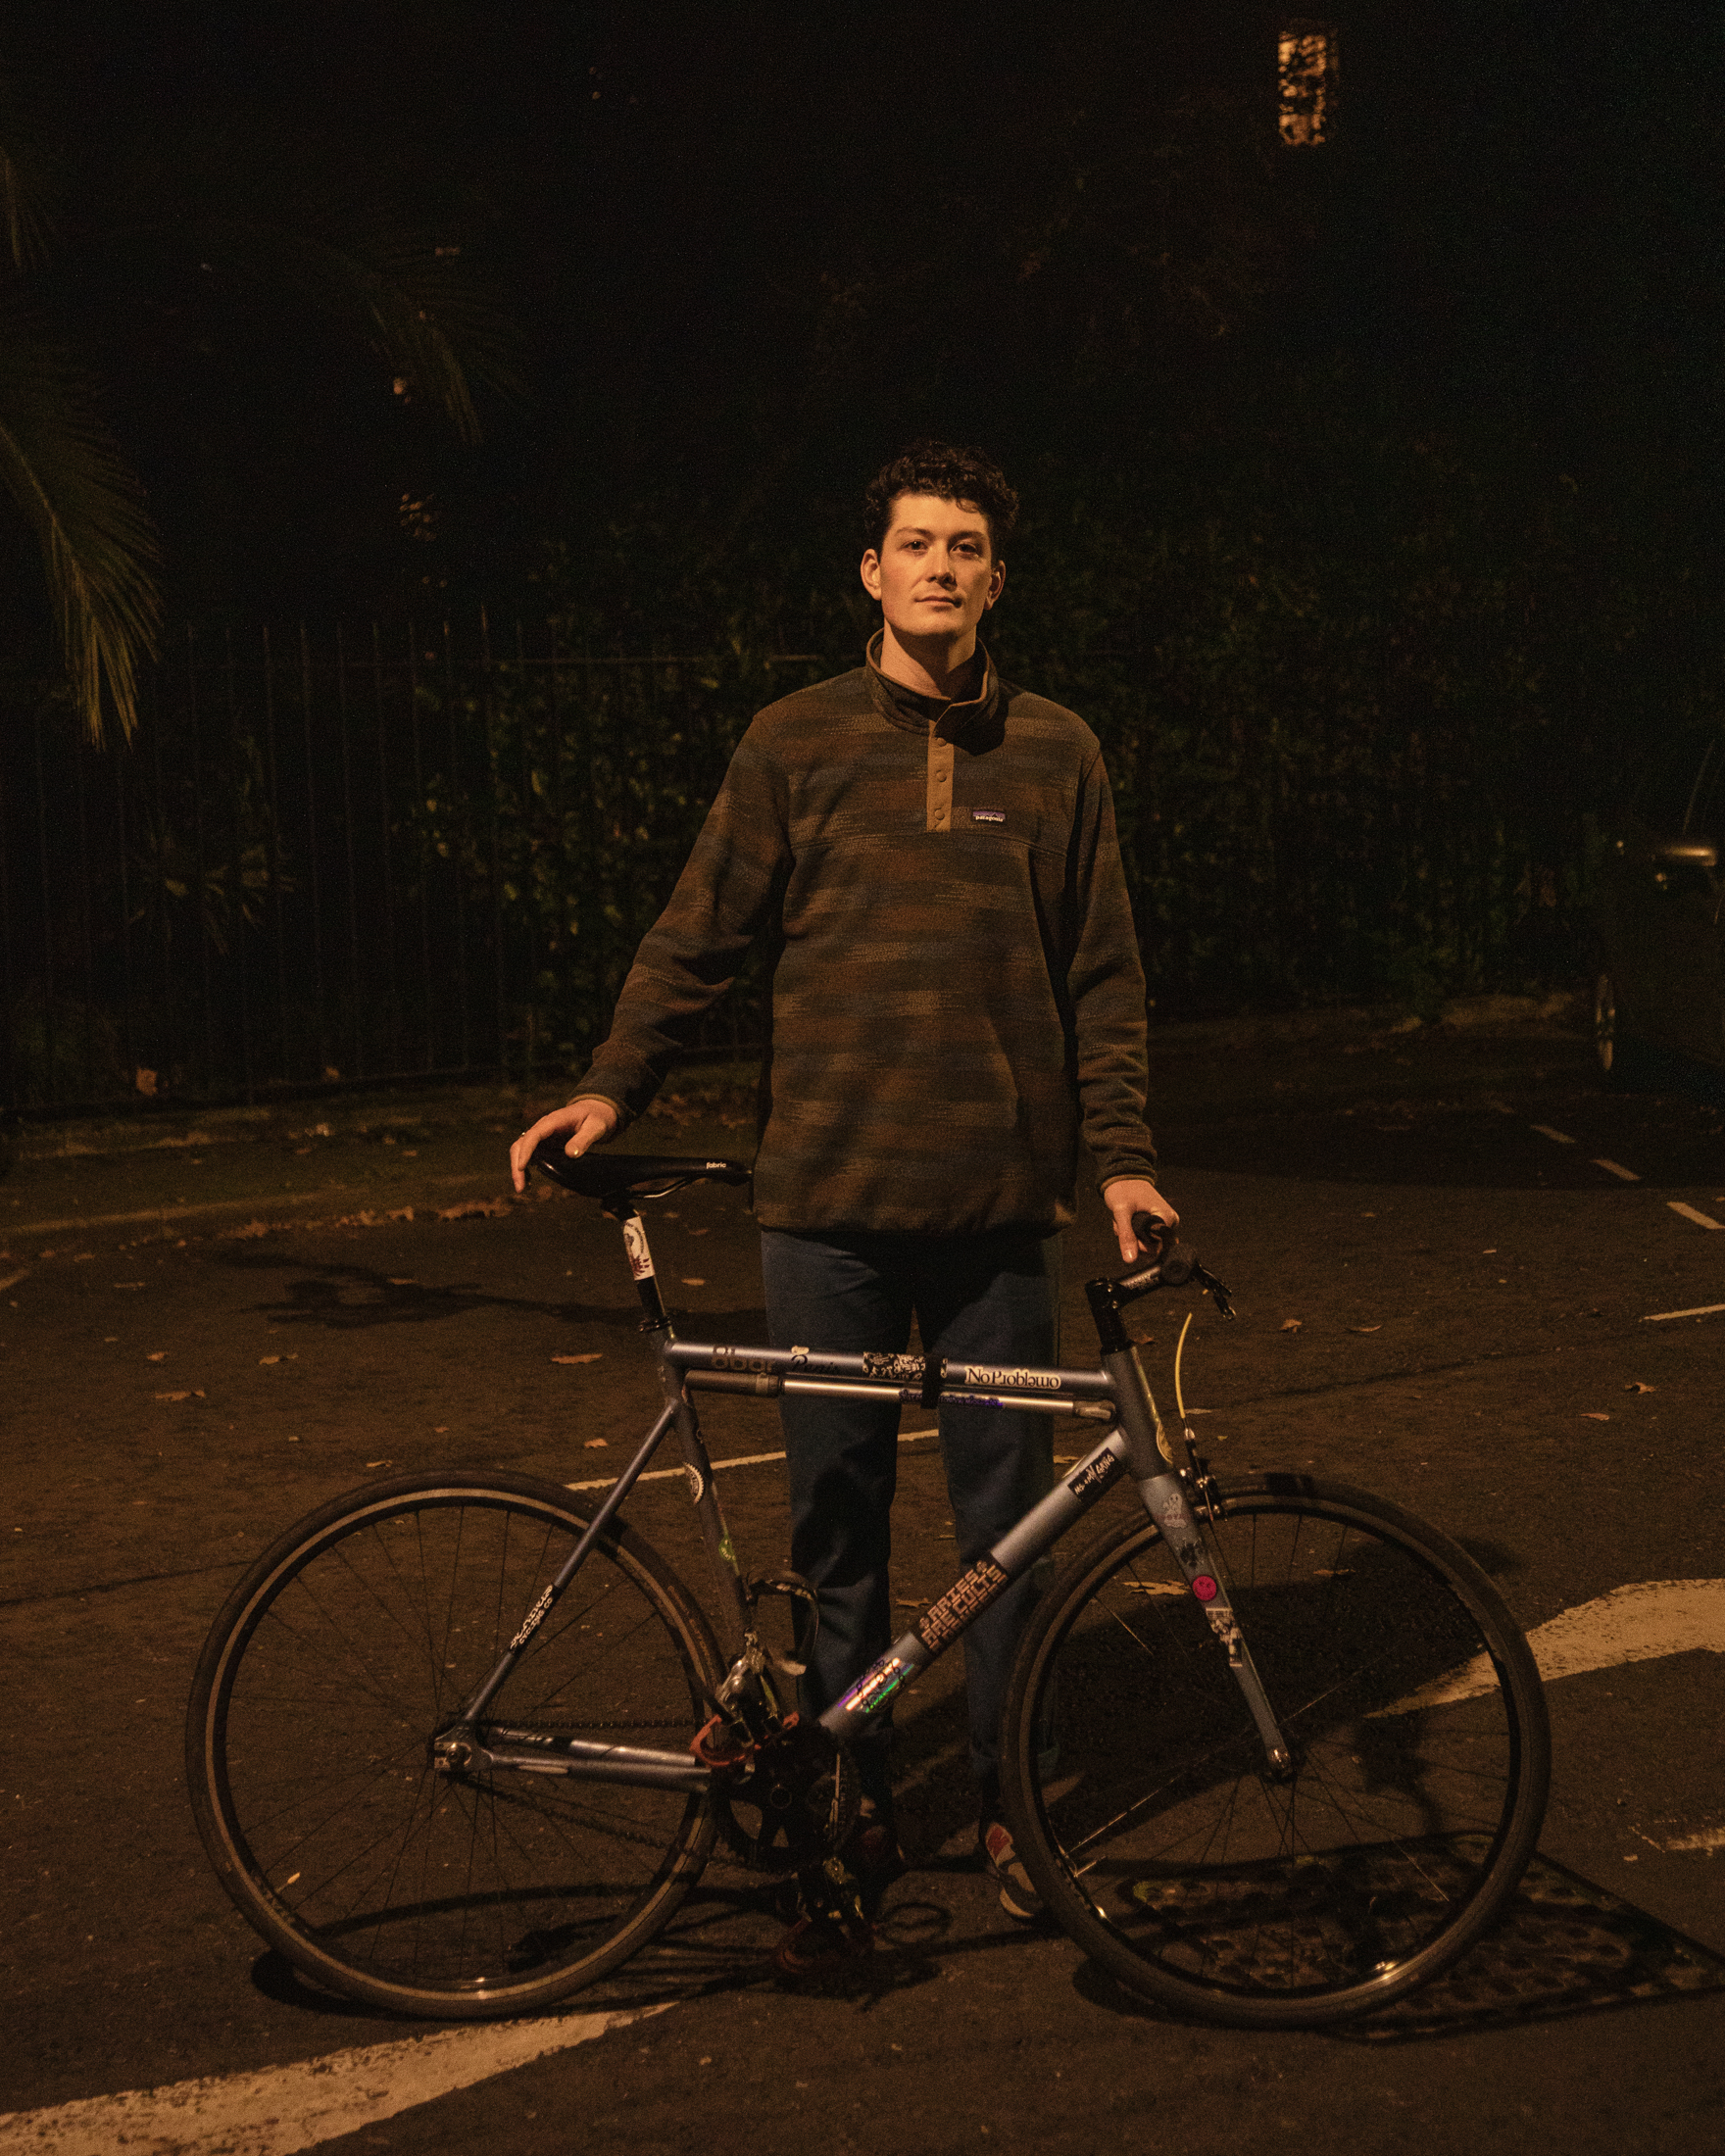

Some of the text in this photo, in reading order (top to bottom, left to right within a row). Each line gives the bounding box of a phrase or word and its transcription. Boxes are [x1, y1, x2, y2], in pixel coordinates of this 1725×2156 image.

[921, 1610, 956, 1643] ARE
[952, 1565, 1002, 1614] CULTS
[927, 1568, 979, 1620] ARIES
